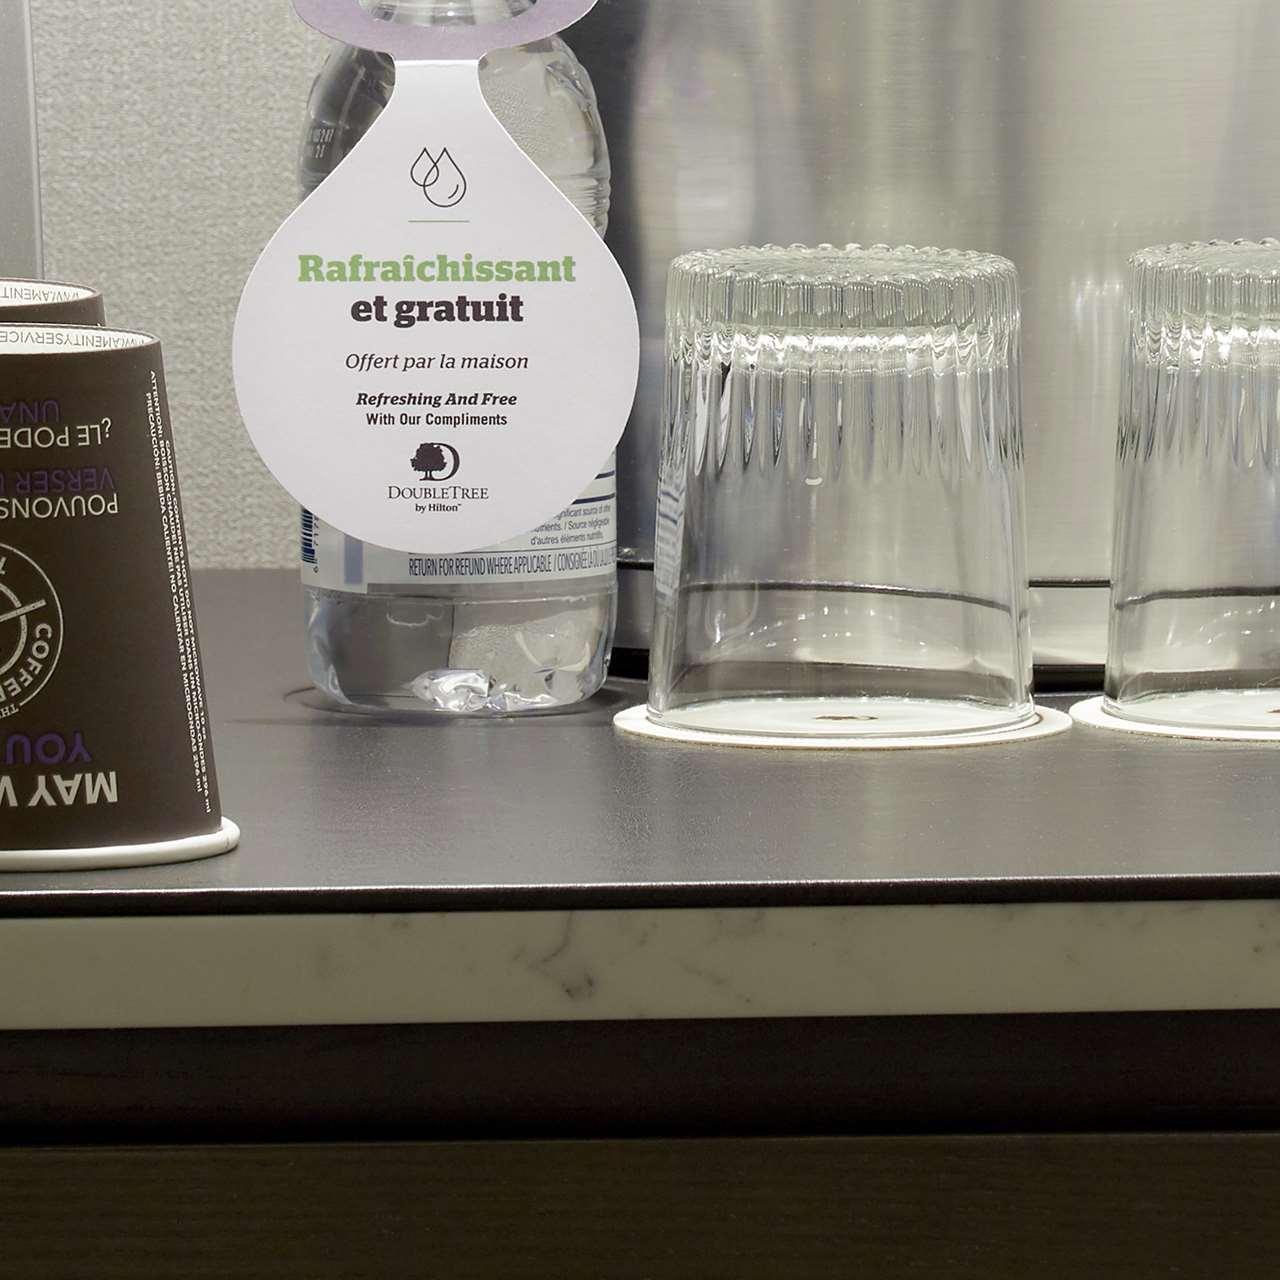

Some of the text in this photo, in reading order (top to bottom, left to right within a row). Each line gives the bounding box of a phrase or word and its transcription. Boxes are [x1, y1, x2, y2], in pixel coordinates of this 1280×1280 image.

[297, 252, 577, 284] Rafraîchissant
[350, 292, 524, 329] et gratuit
[345, 352, 529, 372] Offert par la maison
[151, 371, 163, 438] ATTENTION:
[355, 391, 518, 409] Refreshing And Free
[78, 417, 112, 446] ¿LE
[366, 411, 508, 429] With Our Compliments
[15, 466, 114, 493] VERSER
[160, 440, 170, 491] BOISSON
[156, 472, 166, 514] BEBIDA
[415, 503, 427, 514] by
[173, 547, 179, 563] NE
[531, 536, 559, 545] d'autres
[166, 440, 175, 495] CAUTION:
[173, 497, 184, 558] CONTENTS
[185, 590, 191, 608] DO
[191, 636, 203, 708] MICROWAVE
[409, 558, 438, 576] RETURN
[438, 558, 454, 575] FOR
[455, 557, 486, 575] REFUND
[487, 556, 514, 574] WHERE
[514, 554, 552, 573] APPLICABLE
[170, 574, 177, 593] NO
[173, 595, 184, 653] CALENTAR
[179, 588, 189, 636] UTILISER
[180, 655, 187, 671] EN
[185, 638, 193, 670] DANS
[190, 672, 196, 689] UN
[183, 673, 197, 752] MICROONDAS
[6, 729, 93, 761] YOU
[192, 691, 206, 773] MICRO-ONDES
[27, 770, 119, 807] MAY
[196, 778, 203, 792] ml
[205, 799, 211, 813] ml
